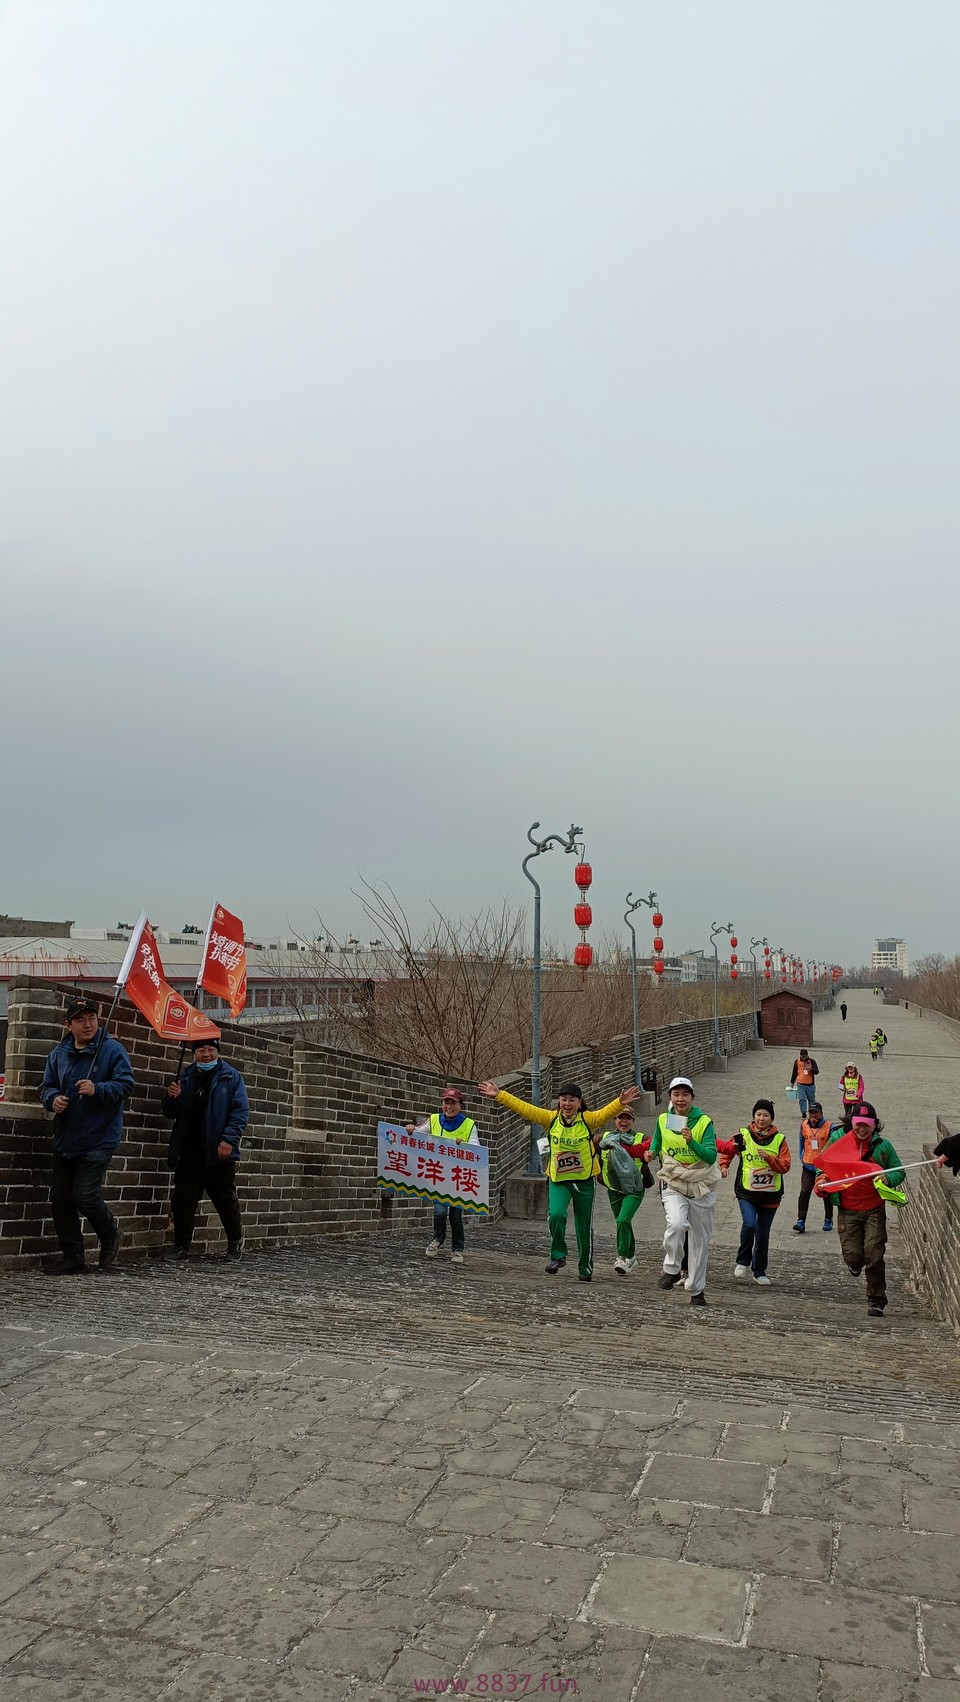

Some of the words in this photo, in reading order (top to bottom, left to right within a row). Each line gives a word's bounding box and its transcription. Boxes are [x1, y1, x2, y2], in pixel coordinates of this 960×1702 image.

[399, 1135, 436, 1153] 青春长城
[557, 1157, 581, 1168] 055
[383, 1149, 482, 1197] 望洋楼
[753, 1174, 774, 1185] 327
